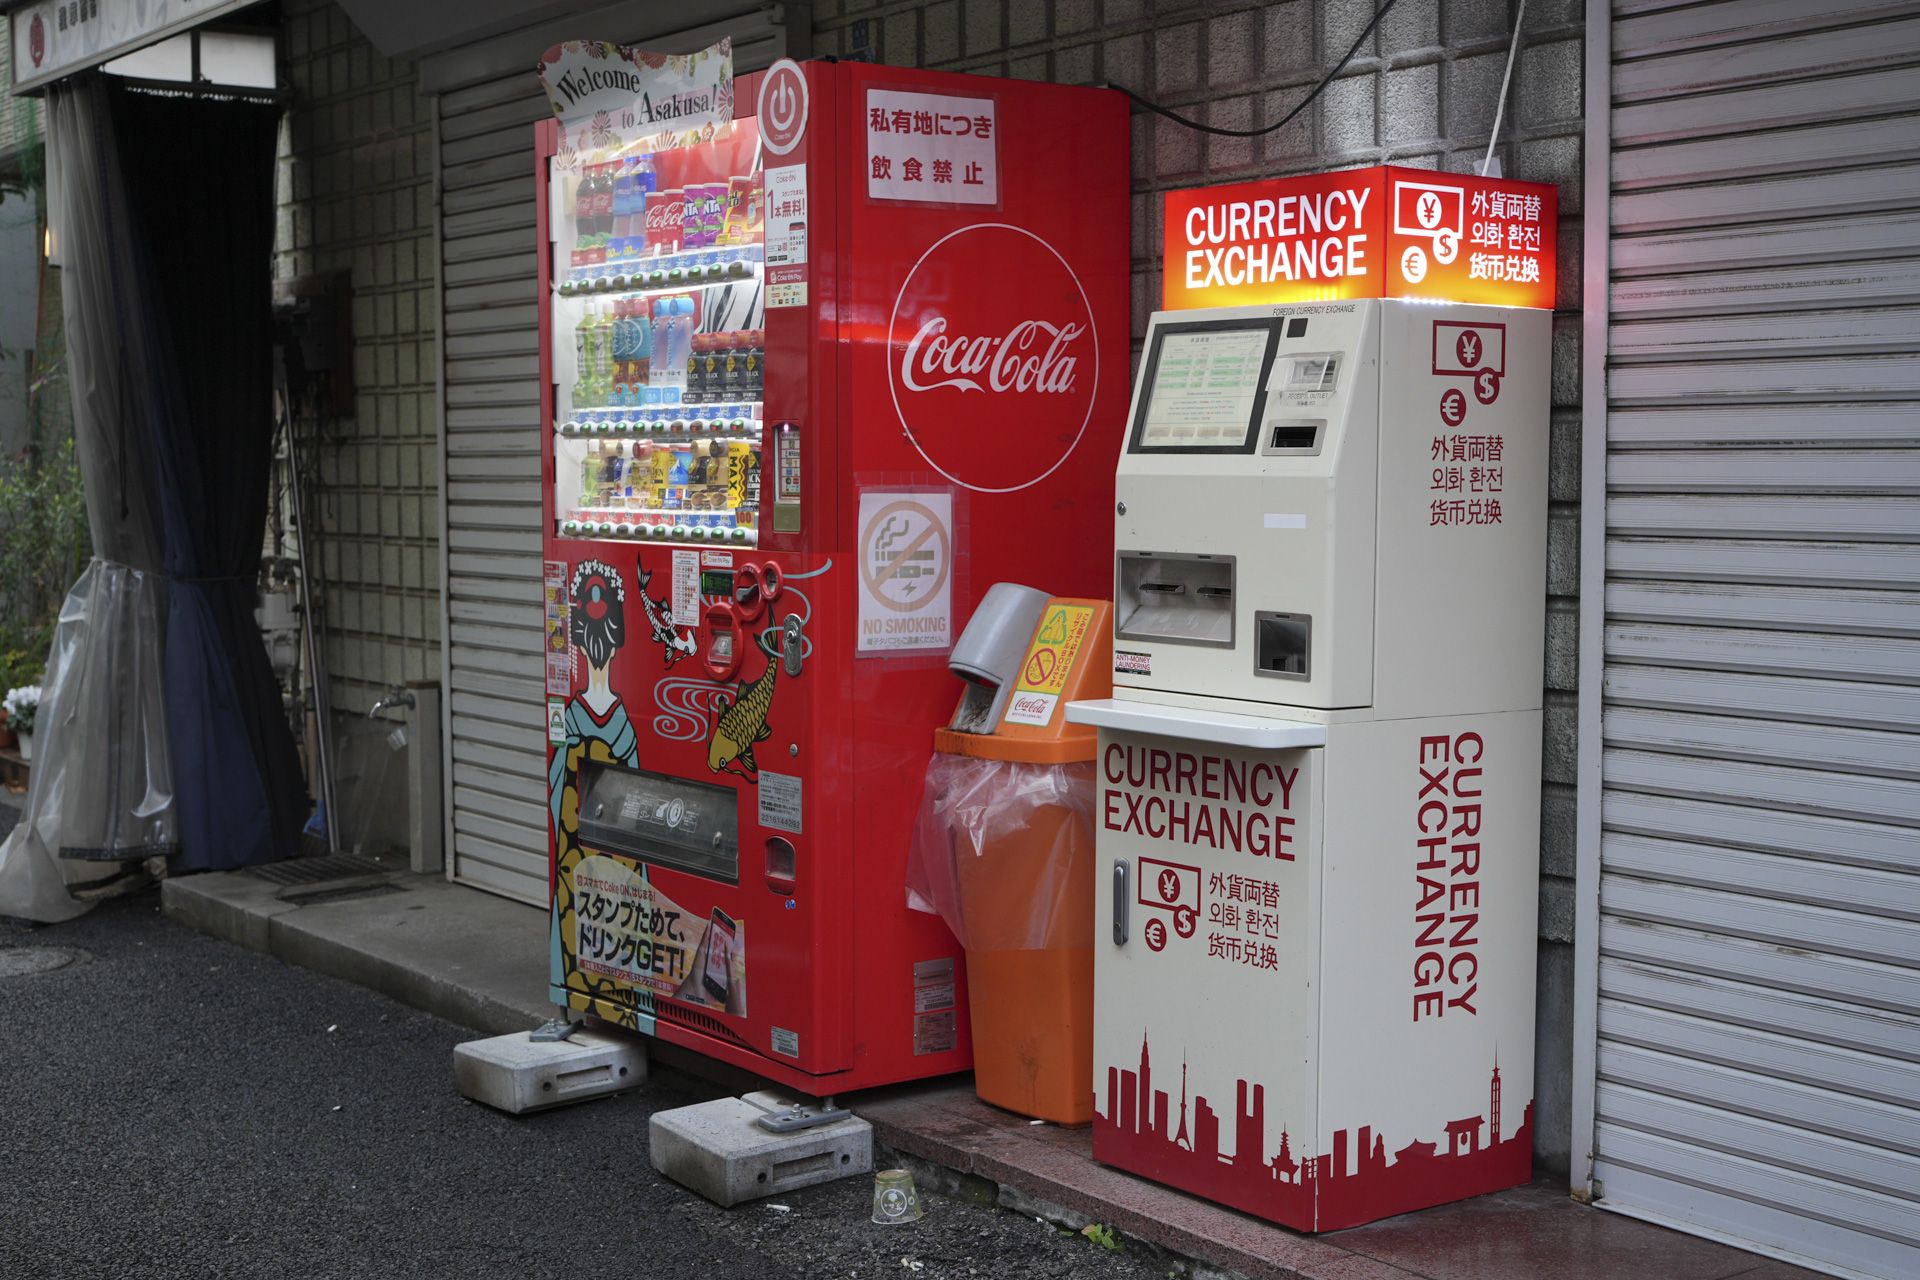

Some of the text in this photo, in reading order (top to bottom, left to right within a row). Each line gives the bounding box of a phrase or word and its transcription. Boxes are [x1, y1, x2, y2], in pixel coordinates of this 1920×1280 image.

[557, 66, 641, 107] Welcome
[622, 83, 718, 129] to Asakusa!
[869, 107, 993, 139] 私有地につき
[871, 153, 984, 186] 飲食禁止
[1185, 187, 1372, 246] CURRENCY
[1470, 190, 1541, 221] 外貨両替
[1470, 221, 1541, 252] 외화 환전
[1185, 234, 1368, 289] EXCHANGE
[1468, 253, 1540, 284] 货币兑换
[1272, 304, 1356, 316] FOREIGN CURRENCY EXCHANGE
[901, 316, 1088, 394] Coca-Cola
[1431, 434, 1504, 463] 外貨両替
[729, 456, 738, 490] MAX
[1430, 465, 1504, 494] 외화 환전
[736, 511, 752, 524] 100
[1429, 497, 1503, 527] 货币兑换
[863, 616, 946, 636] NO SMOKING
[1115, 660, 1151, 671] LAUNDERING
[1116, 654, 1151, 664] ANTI-MONEY
[1014, 696, 1049, 715] Coca-Cola
[1103, 742, 1299, 810] CURRENCY
[1103, 789, 1296, 862] EXCHANGE
[1208, 871, 1280, 909] 外貨両替
[1412, 735, 1450, 1022] EXCHANGE
[1447, 731, 1485, 1016] CURRENCY
[577, 891, 686, 943] スタンプためて、
[1208, 901, 1280, 940] 외화 환전
[578, 923, 686, 981] ドリンクGET!
[1207, 931, 1279, 971] 货币兑换
